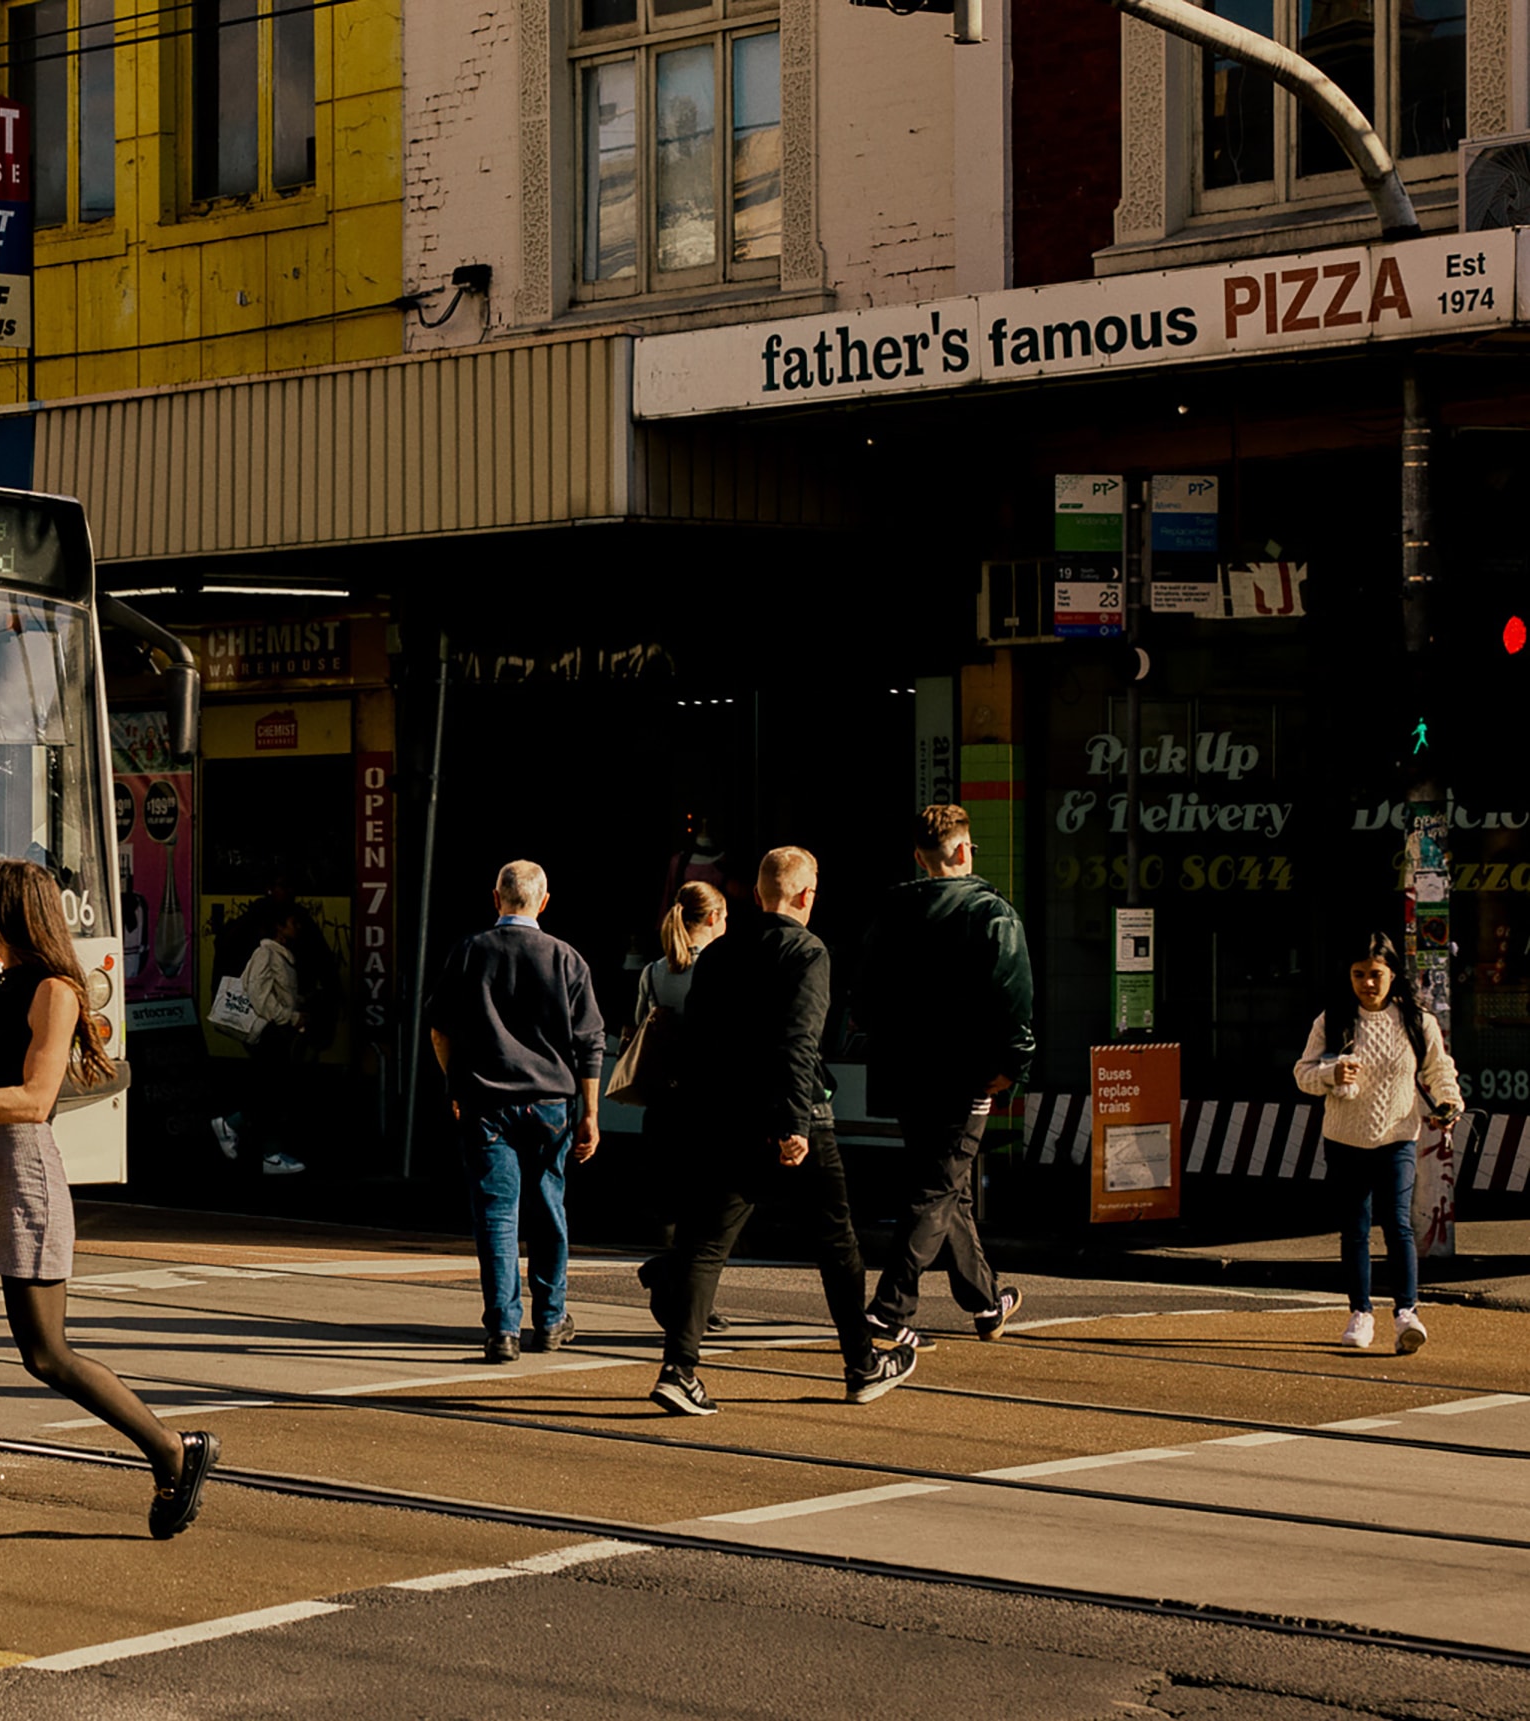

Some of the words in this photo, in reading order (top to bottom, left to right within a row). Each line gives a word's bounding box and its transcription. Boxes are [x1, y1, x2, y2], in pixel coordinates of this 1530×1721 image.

[1446, 252, 1486, 278] Est
[1437, 287, 1495, 315] 1974
[761, 311, 971, 393] father's
[988, 306, 1198, 368] famous
[1223, 256, 1413, 339] PIZZA
[1099, 590, 1119, 608] 23
[207, 620, 342, 658] CHEMIST
[208, 656, 342, 678] WAREHOUSE
[256, 722, 297, 738] CHEMIST
[1195, 730, 1260, 781] Up
[363, 766, 387, 869] OPEN
[1055, 789, 1098, 835] &
[1107, 791, 1295, 839] Delivery
[1054, 853, 1165, 892] 9380
[1178, 853, 1295, 892] 8044
[61, 888, 95, 927] 06
[361, 880, 388, 915] 7
[363, 924, 387, 1027] DAYS
[1097, 1066, 1133, 1082] Buses
[1479, 1068, 1530, 1099] 938
[1097, 1084, 1141, 1100] replace
[1098, 1099, 1132, 1115] trains
